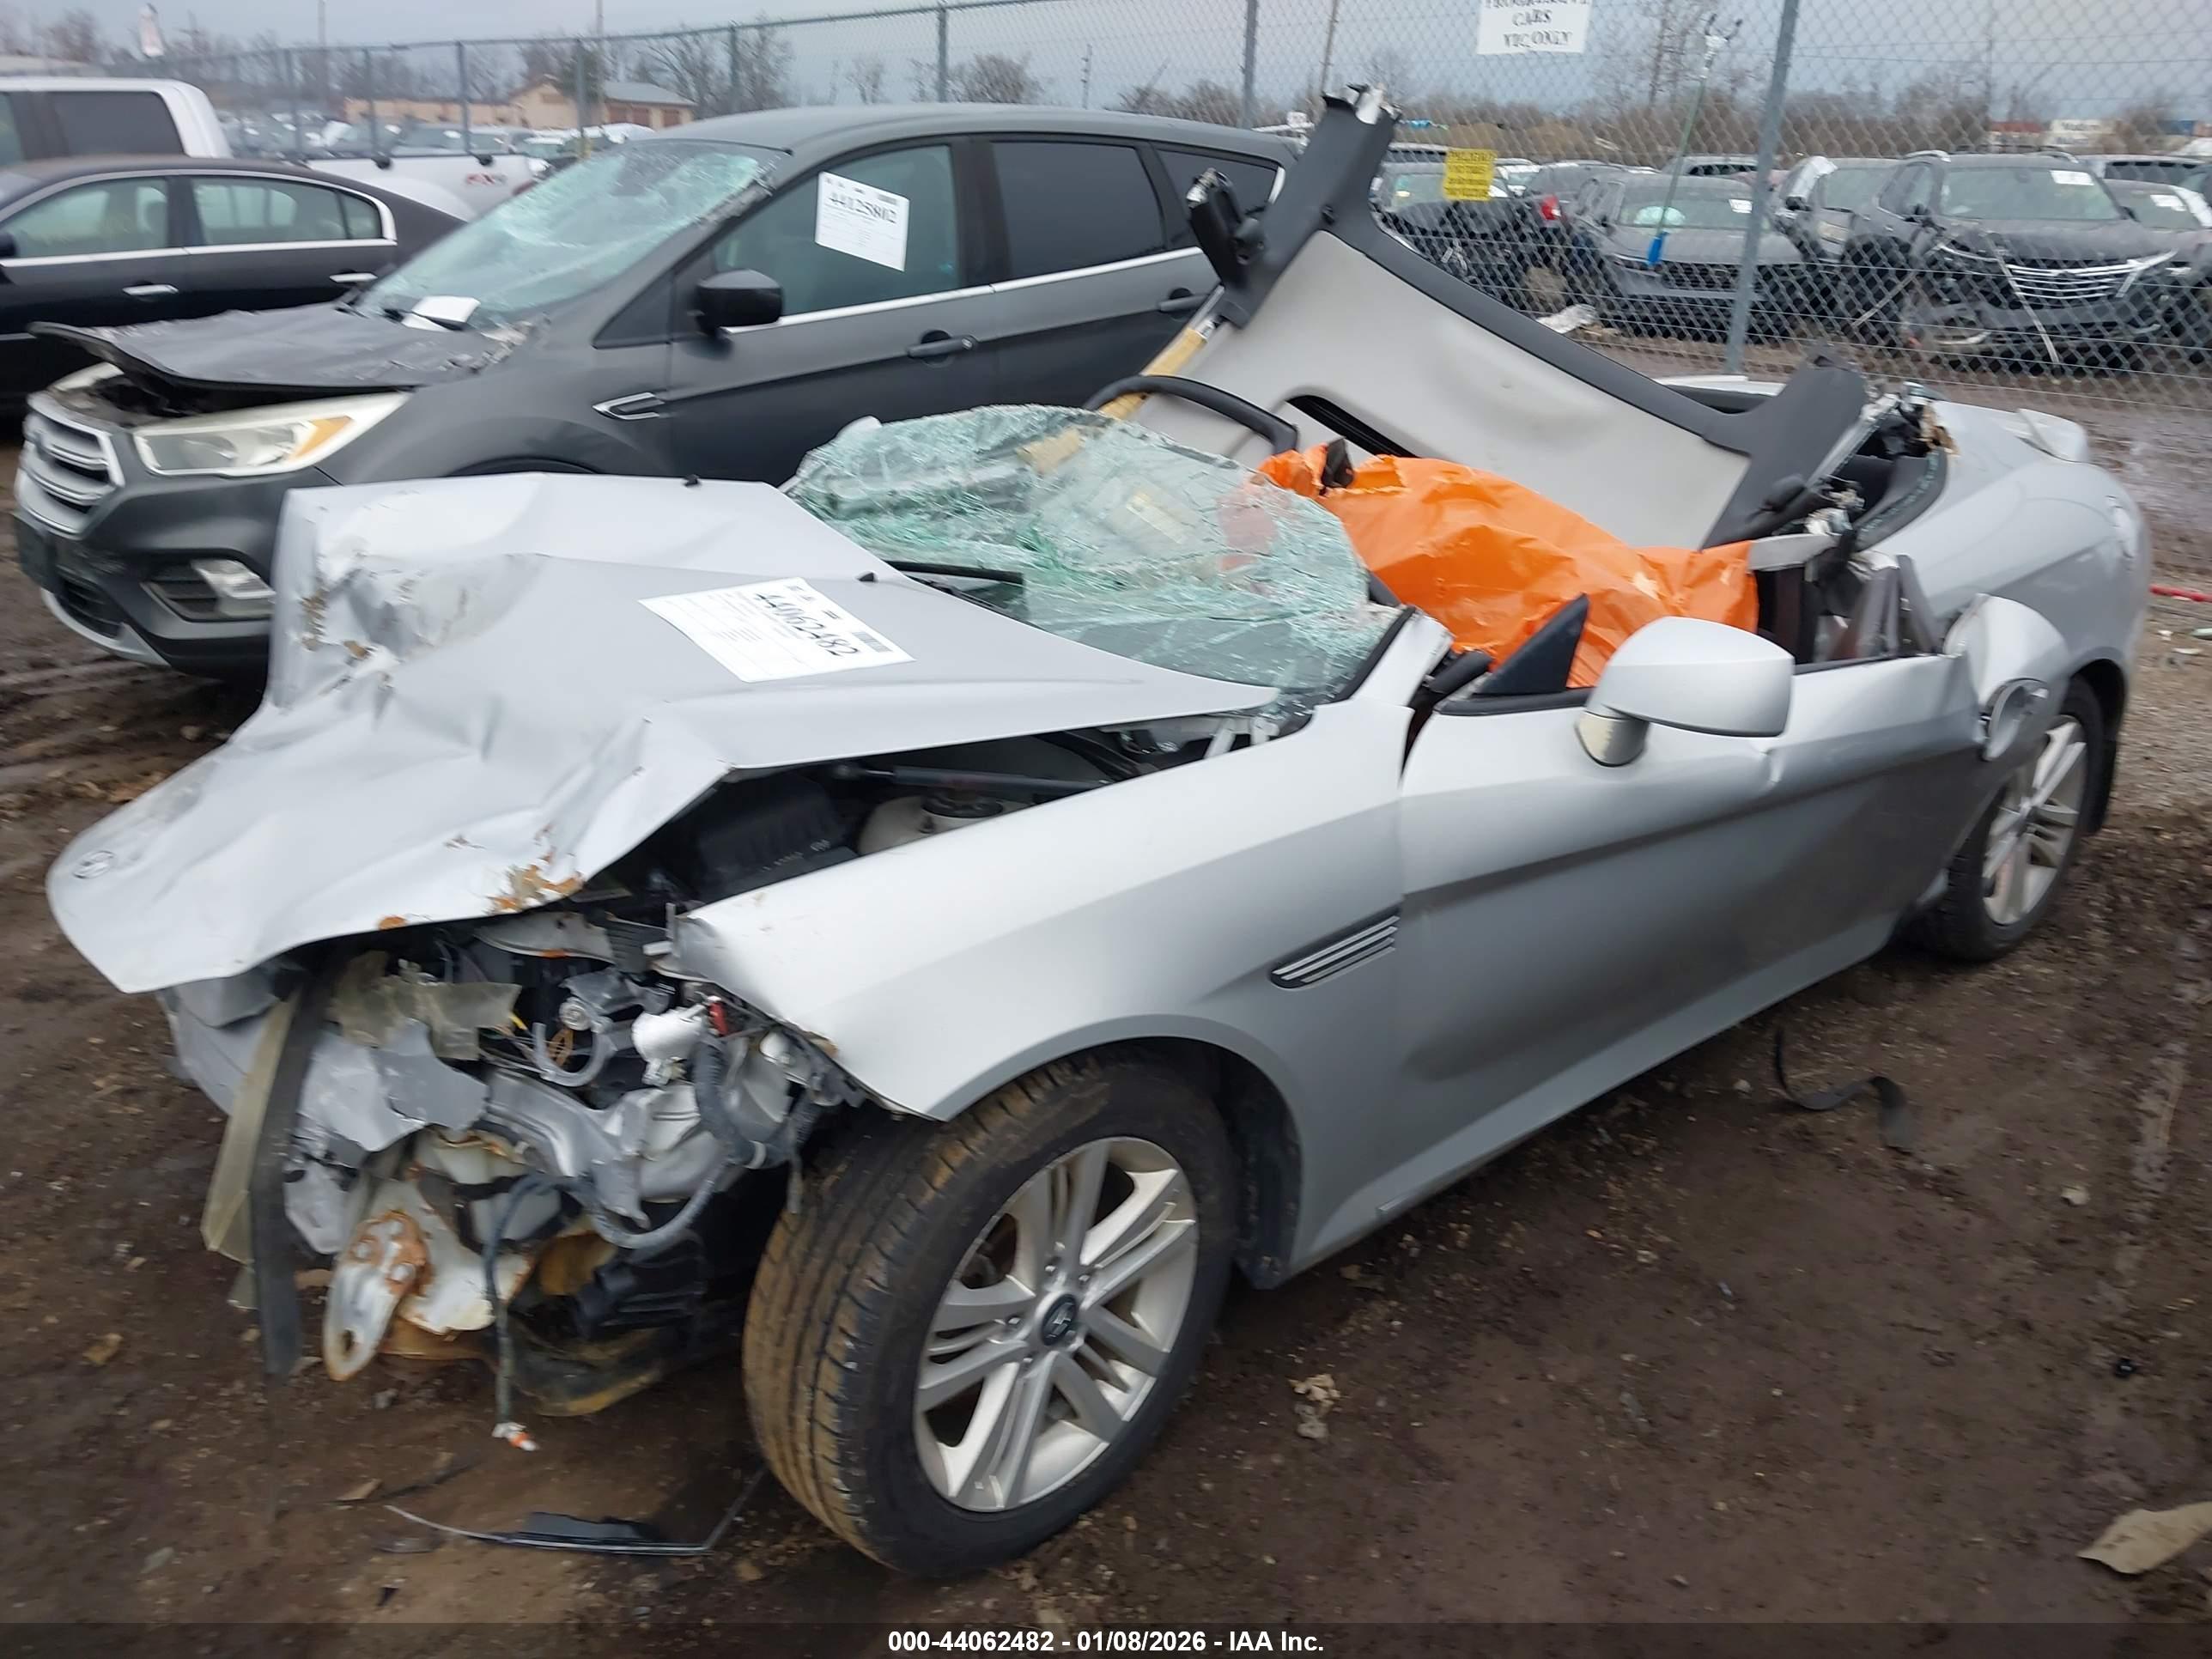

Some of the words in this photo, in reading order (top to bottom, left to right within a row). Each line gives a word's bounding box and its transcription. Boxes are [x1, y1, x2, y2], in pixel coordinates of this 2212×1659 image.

[1511, 9, 1552, 27] CARS
[1530, 30, 1573, 46] ONLY
[756, 593, 860, 656] 44062482
